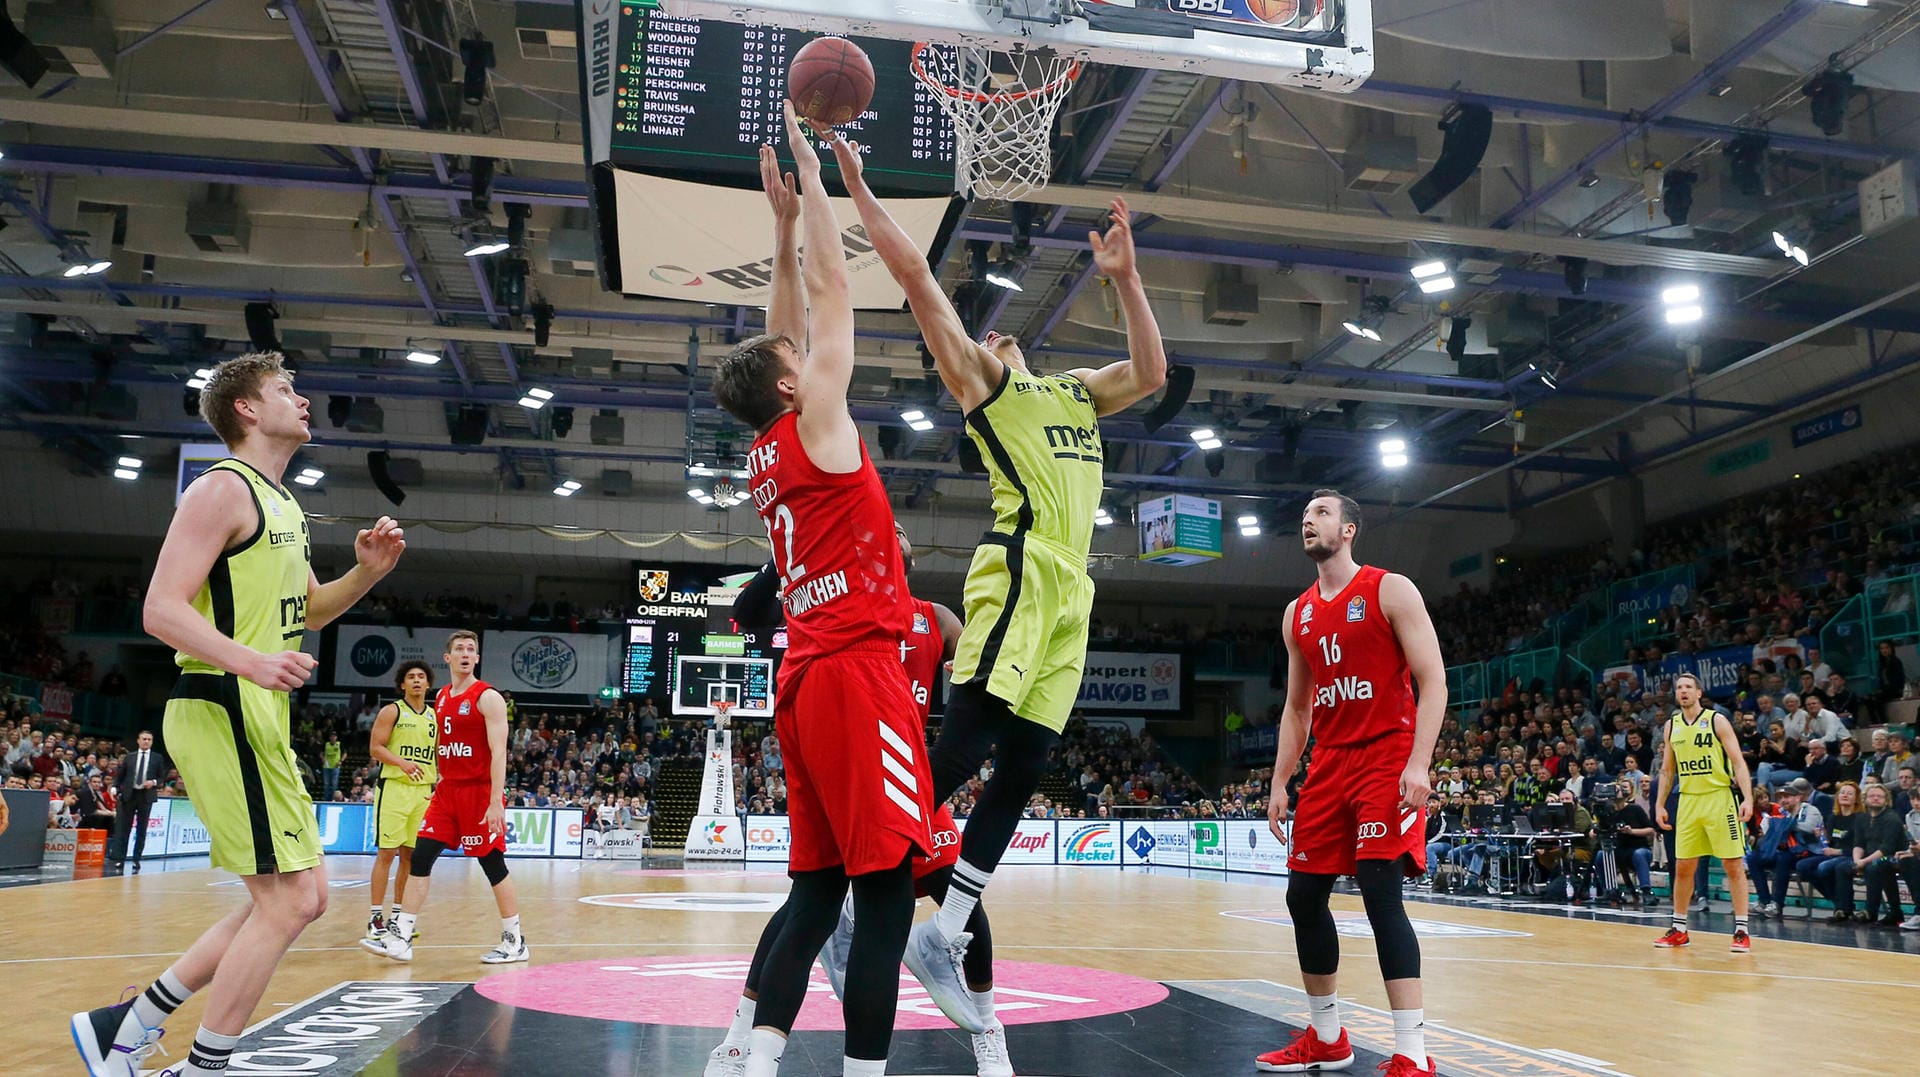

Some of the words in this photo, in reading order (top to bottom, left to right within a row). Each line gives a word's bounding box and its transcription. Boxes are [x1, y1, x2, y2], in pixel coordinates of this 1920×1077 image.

[639, 9, 644, 17] 3
[1179, 0, 1232, 14] BBL
[638, 20, 643, 28] 7
[649, 21, 701, 34] FENEBERG
[647, 32, 697, 45] WOODARD
[593, 18, 609, 97] REHAU
[632, 42, 640, 51] 11
[646, 44, 694, 56] SEIFERTH
[743, 54, 754, 62] 02
[646, 55, 690, 67] MEISNER
[630, 66, 640, 74] 20
[645, 66, 684, 78] ALFORD
[742, 76, 753, 84] 03
[645, 78, 706, 92] PERSCHNICK
[742, 88, 752, 96] 00
[628, 89, 639, 98] 22
[644, 90, 679, 101] TRAVIS
[741, 99, 752, 108] 02
[627, 101, 638, 109] 33
[644, 101, 696, 114] BRUINSMA
[740, 111, 751, 119] 02
[915, 105, 924, 113] 10
[626, 112, 638, 120] 34
[643, 113, 685, 125] PRYSZCZ
[740, 122, 750, 130] 00
[914, 116, 924, 124] 00
[626, 124, 637, 132] 44
[642, 125, 685, 137] LINHART
[739, 134, 750, 142] 02
[804, 128, 813, 136] 31
[913, 128, 923, 136] 02
[913, 139, 923, 147] 00
[912, 150, 922, 158] 05
[707, 224, 875, 290] REU
[269, 530, 295, 545] brose
[637, 605, 708, 618] OBERFRA
[668, 632, 679, 641] 21
[744, 634, 755, 643] 33
[356, 647, 389, 665] GMK
[1318, 632, 1342, 666] 16
[1697, 656, 1741, 691] Weiss
[1078, 683, 1146, 702] JAKOB
[429, 724, 435, 738] 3
[444, 716, 451, 734] 5
[1694, 733, 1713, 748] 44
[400, 745, 434, 760] medi
[438, 742, 472, 758] ayWa
[714, 765, 724, 814] Piotrowski
[1727, 814, 1738, 840] REHAU
[44, 843, 75, 851] RADIO
[1009, 832, 1051, 853] Zapf
[688, 846, 742, 855] www.pio-24.de
[1066, 849, 1115, 861] Heckel
